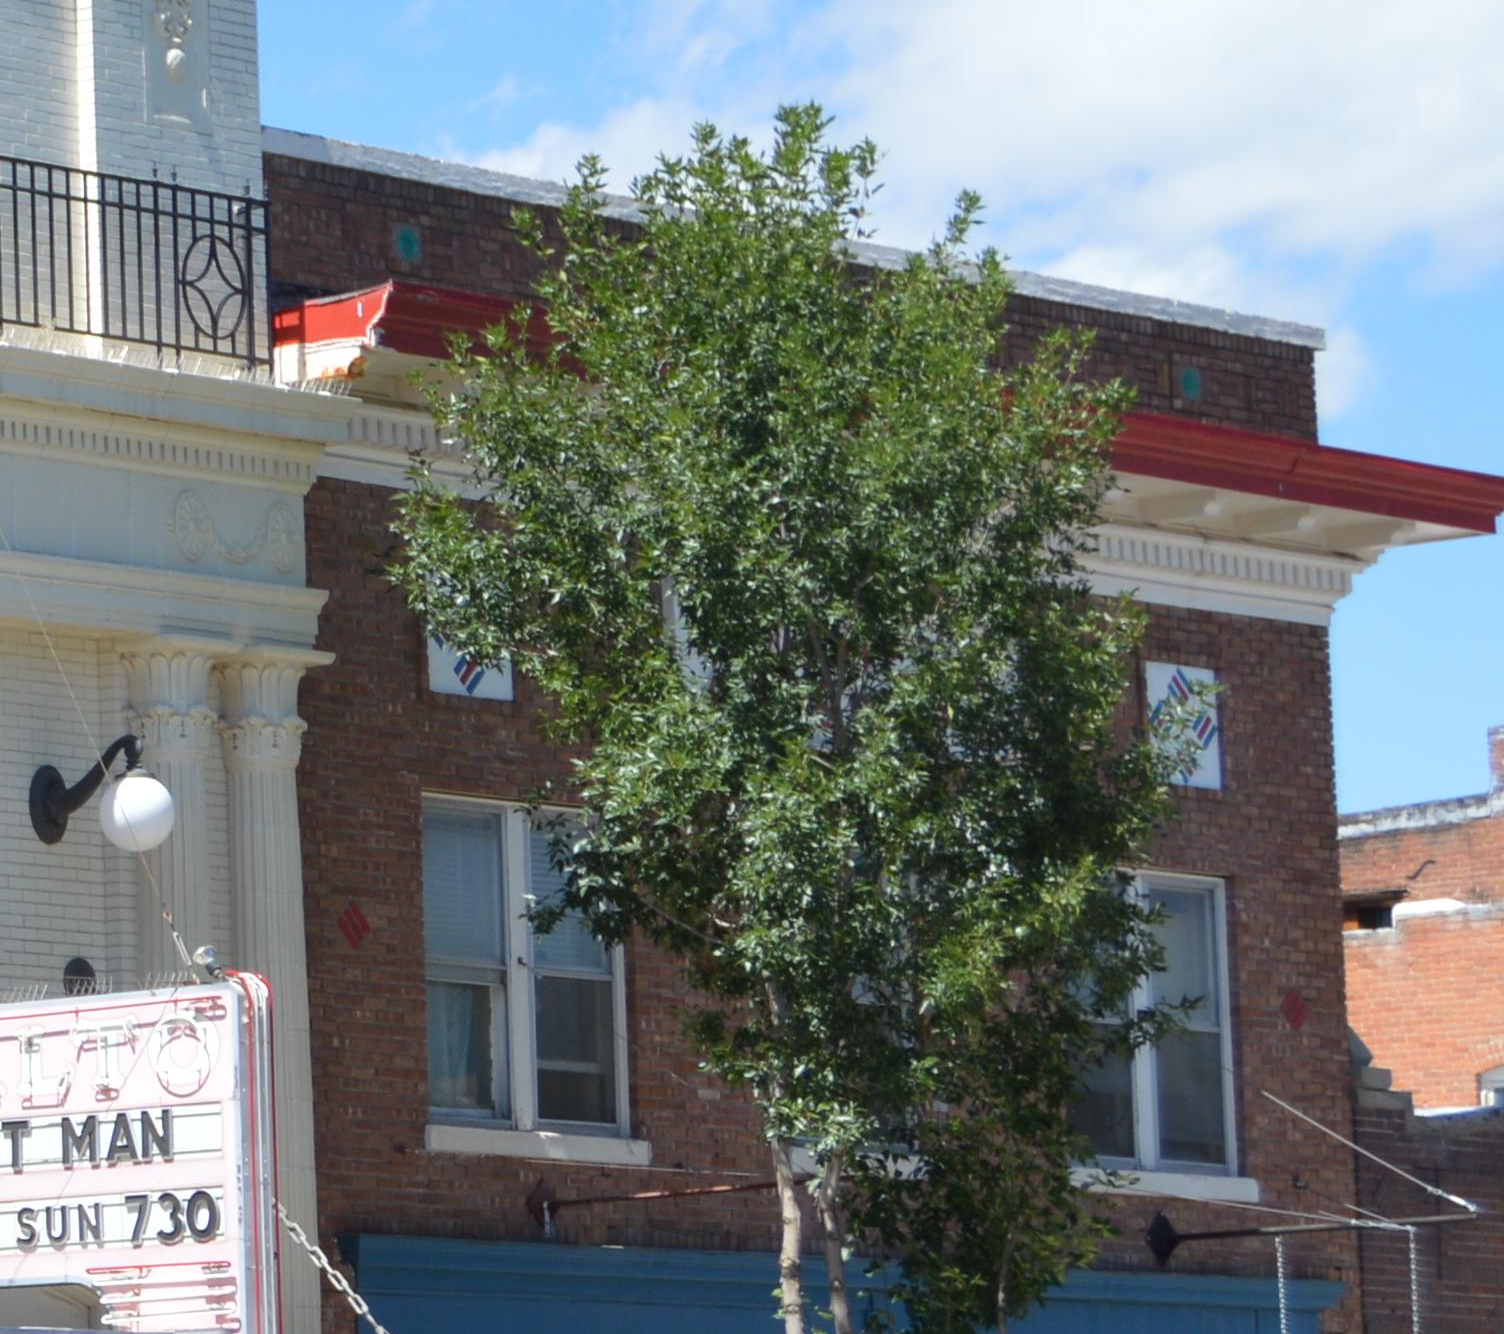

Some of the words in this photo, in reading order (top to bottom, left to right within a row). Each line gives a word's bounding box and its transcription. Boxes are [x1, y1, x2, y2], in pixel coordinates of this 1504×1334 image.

[61, 1108, 176, 1170] MAN
[16, 1201, 106, 1255] SUN
[124, 1189, 221, 1249] 730
